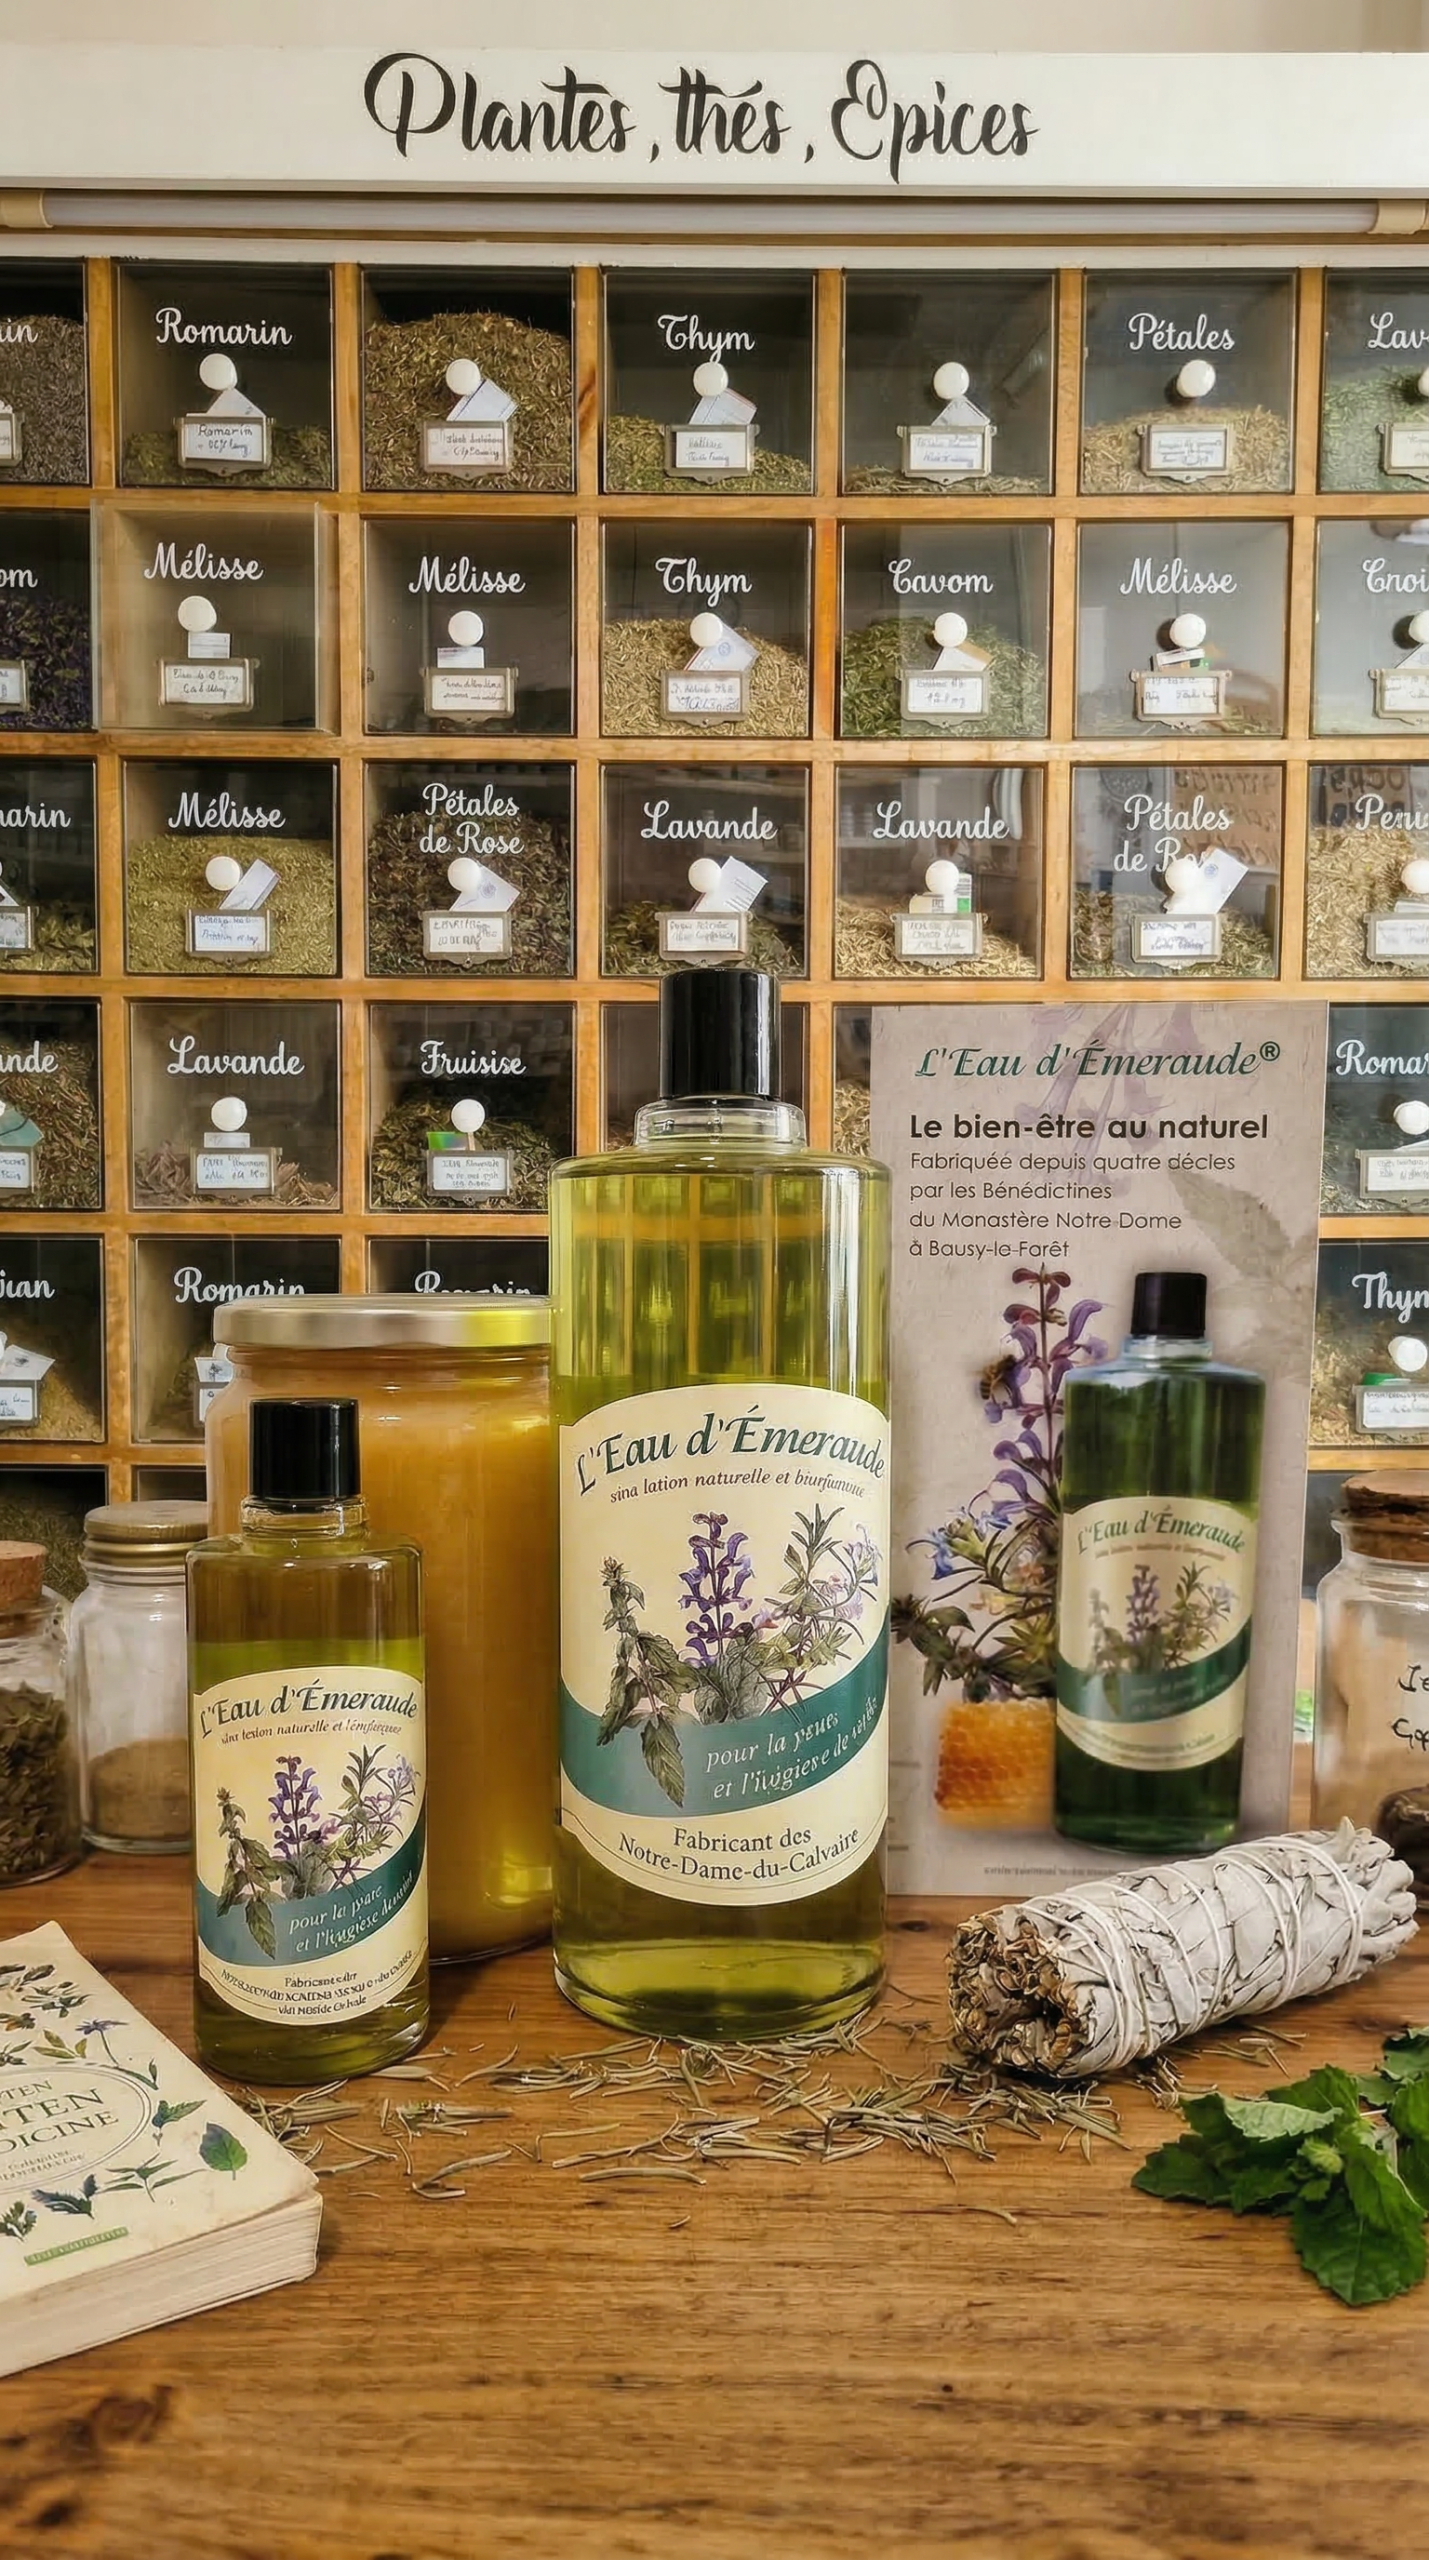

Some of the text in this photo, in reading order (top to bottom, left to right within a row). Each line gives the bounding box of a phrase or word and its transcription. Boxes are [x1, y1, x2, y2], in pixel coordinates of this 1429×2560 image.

[831, 58, 1041, 184] Epices
[0, 317, 39, 343] in
[155, 307, 292, 346] Romarin
[657, 314, 755, 362] Thym
[1128, 312, 1235, 350] Pétales
[144, 542, 264, 581] Mélisse
[408, 556, 526, 594] Mélisse
[1120, 557, 1238, 595] Mélisse
[655, 557, 752, 607] Thym
[168, 792, 286, 829] Mélisse
[422, 782, 520, 818] Pétales
[1123, 793, 1231, 832] Pétales
[419, 821, 524, 855] de Rose
[640, 800, 778, 840] Lavande
[872, 800, 1009, 840] Lavande
[1113, 840, 1147, 872] de
[0, 1040, 58, 1074] nde
[167, 1035, 305, 1076] Lavande
[914, 1047, 1027, 1078] L'Eau
[910, 1112, 1269, 1140] Le bien-être au naturel
[911, 1151, 1012, 1173] Fabriquéé
[1019, 1153, 1087, 1174] depuis
[1093, 1154, 1161, 1174] quatre
[910, 1180, 1112, 1203] par les Bénédictines
[909, 1211, 935, 1228] du
[942, 1210, 1050, 1229] Monastère
[929, 1240, 1070, 1261] Bausy-le-Farêt
[577, 1404, 885, 1496] L'Eau d'Émeraude
[695, 1467, 771, 1487] naturelle
[776, 1470, 790, 1485] et
[1078, 1520, 1129, 1555] L'Eau
[200, 1678, 418, 1740] L'Eau d'Émeraude
[277, 1719, 329, 1736] naturelle
[332, 1721, 343, 1732] et
[706, 1744, 759, 1773] pour
[767, 1733, 787, 1756] la
[713, 1781, 733, 1799] et
[619, 1828, 860, 1881] Notre-Dame-du-Calvaire
[673, 1826, 812, 1853] Fabricant des
[289, 1912, 328, 1935] pour
[0, 2079, 53, 2100] TEN
[0, 2088, 104, 2130] TEN
